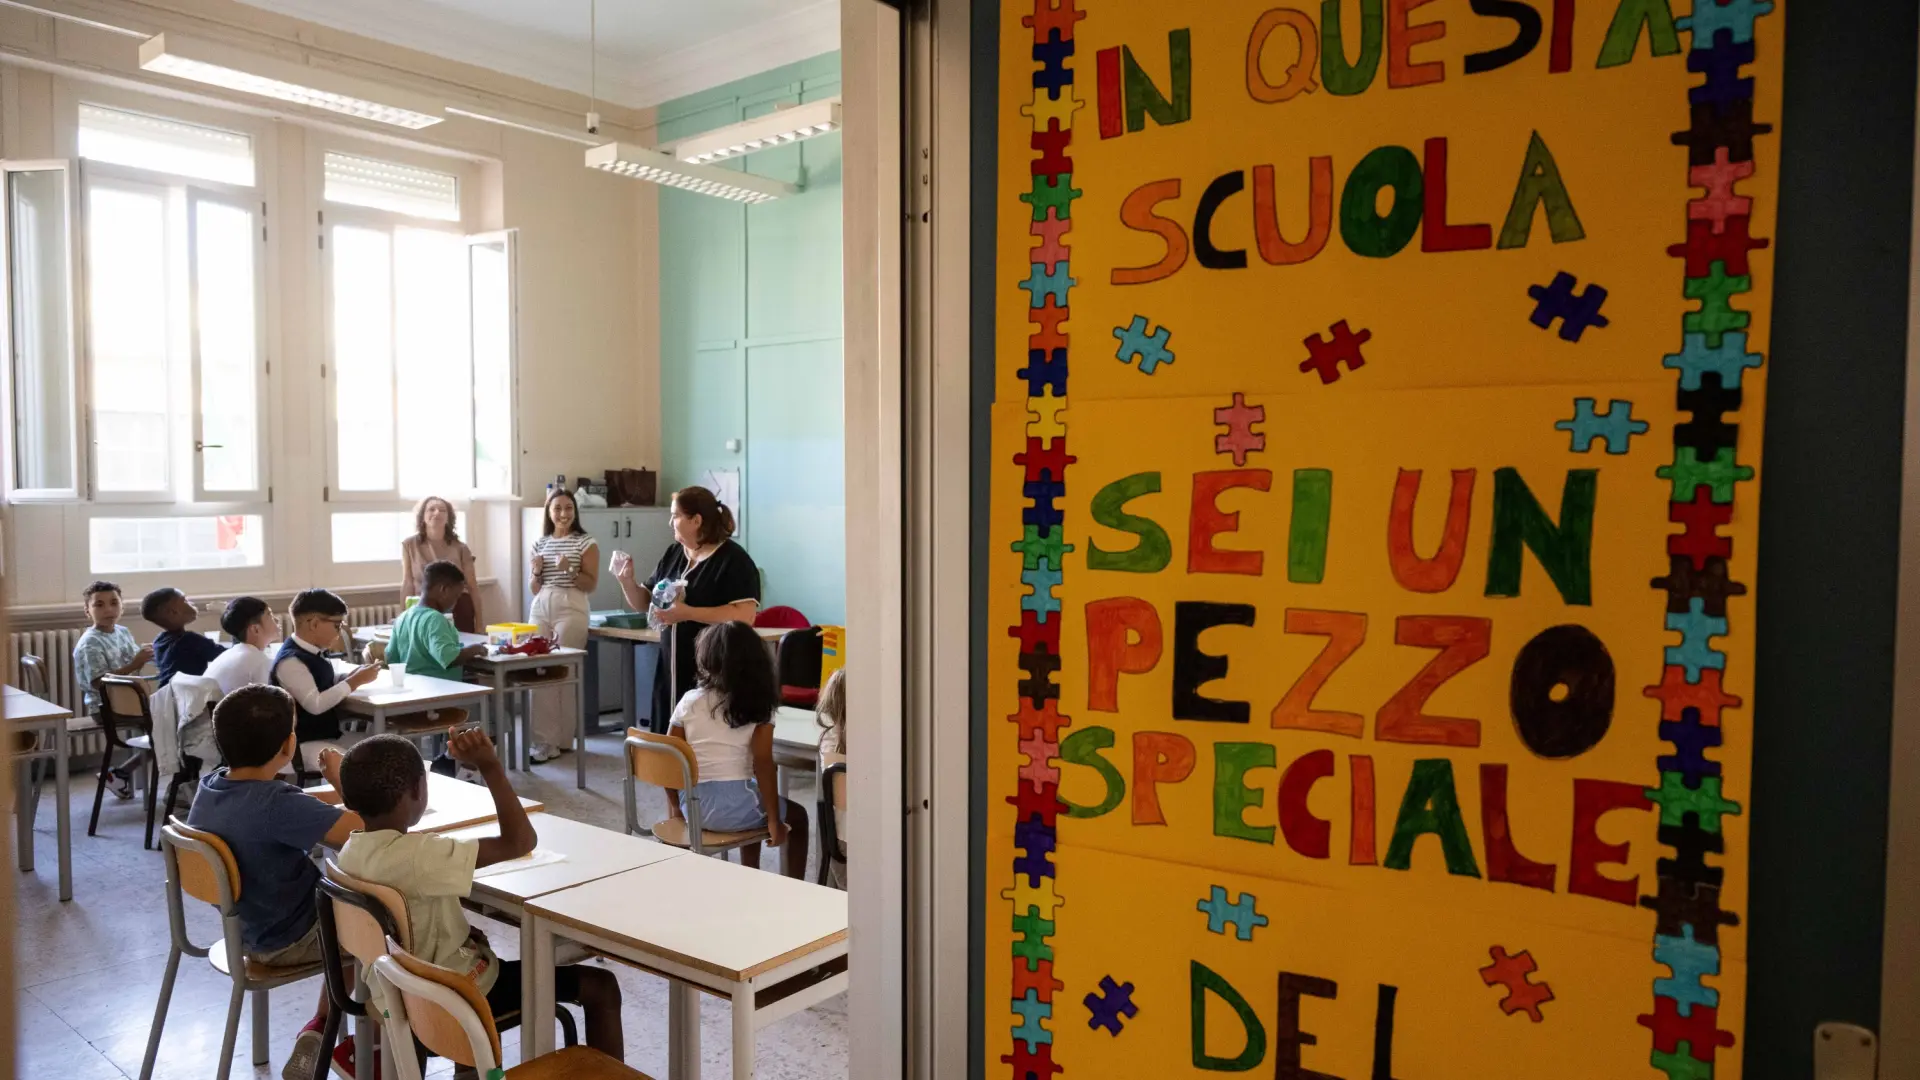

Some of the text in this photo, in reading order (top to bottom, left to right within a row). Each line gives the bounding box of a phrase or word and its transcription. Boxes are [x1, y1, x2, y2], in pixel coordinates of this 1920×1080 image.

[1097, 28, 1191, 140] IN
[1111, 130, 1586, 286] SCUOLA
[1087, 467, 1600, 607] SEI UN
[1085, 596, 1616, 758] PEZZO
[1058, 725, 1654, 908] SPECIALE
[1190, 959, 1401, 1080] DEL
